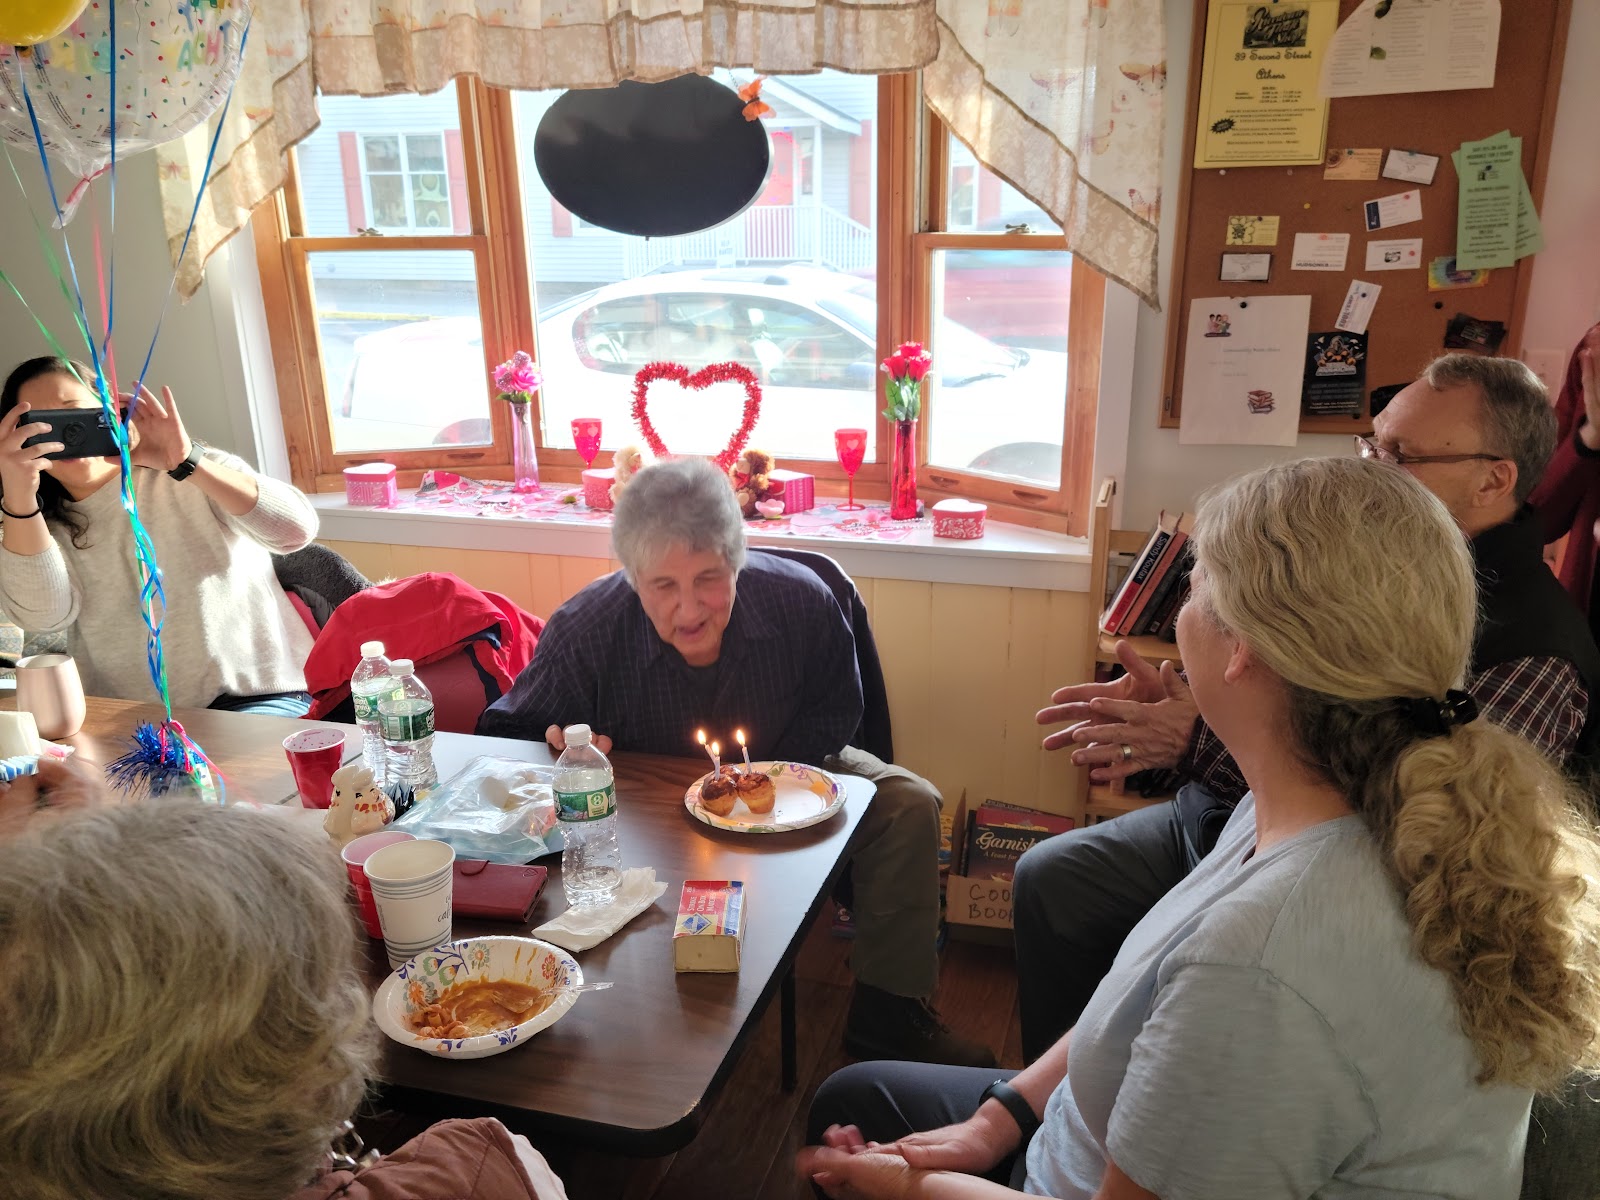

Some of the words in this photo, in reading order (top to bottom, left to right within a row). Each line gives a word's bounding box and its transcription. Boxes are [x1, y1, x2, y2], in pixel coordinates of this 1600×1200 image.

[1249, 49, 1281, 61] Second
[1284, 48, 1312, 60] Street
[1255, 67, 1287, 80] Athens
[1149, 535, 1167, 557] Sandy
[1136, 557, 1155, 580] Koufax
[970, 884, 1011, 902] COO
